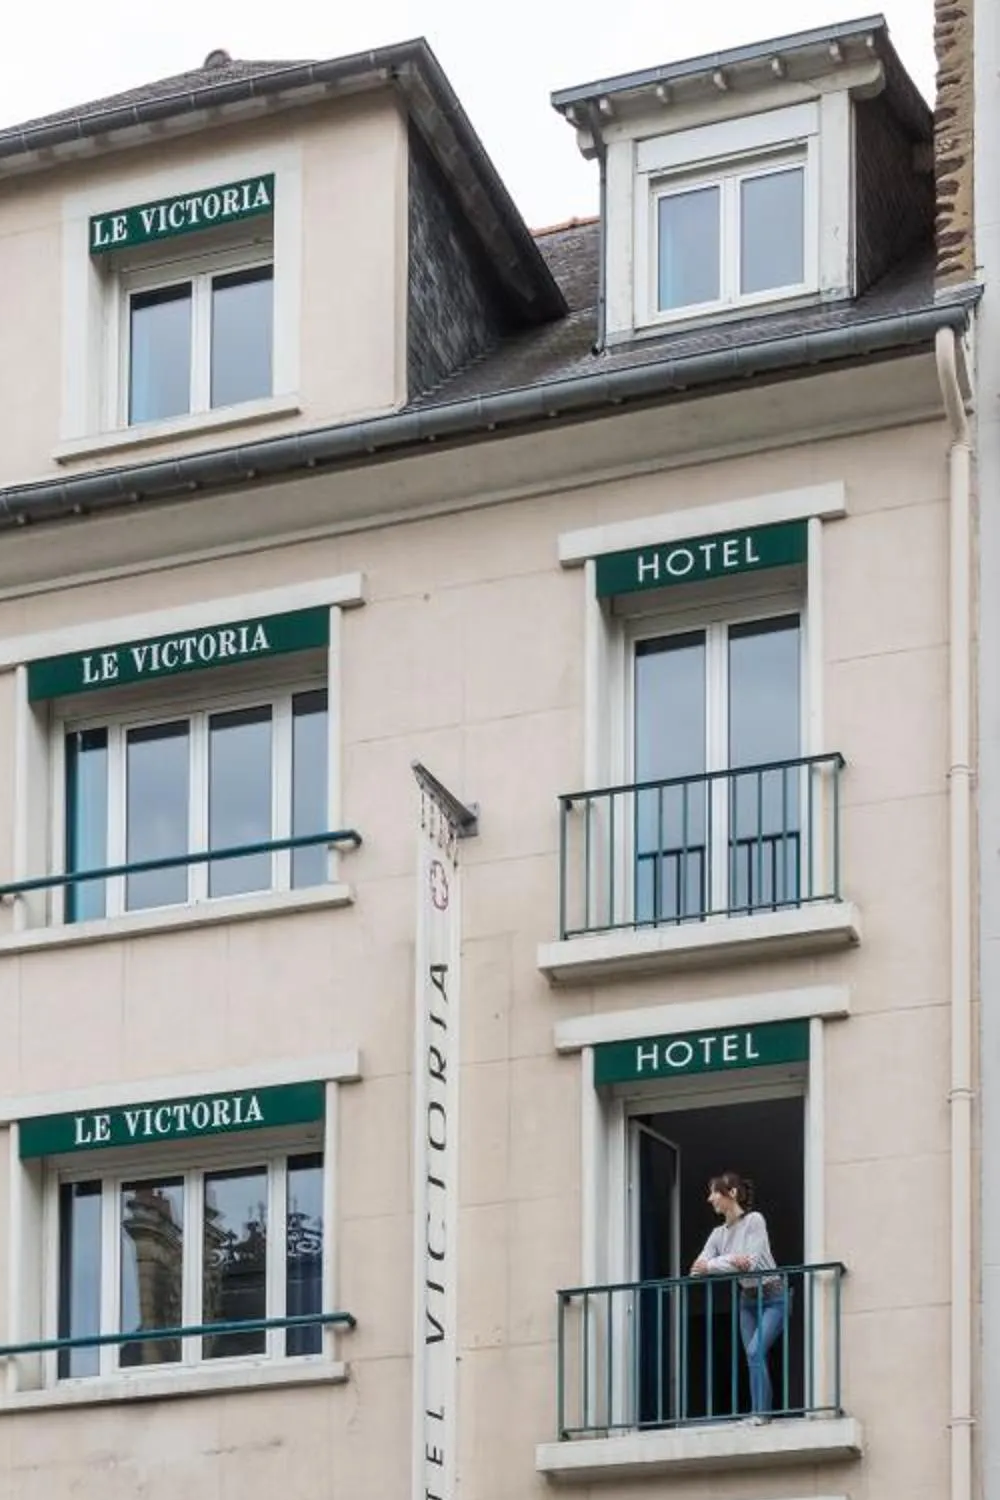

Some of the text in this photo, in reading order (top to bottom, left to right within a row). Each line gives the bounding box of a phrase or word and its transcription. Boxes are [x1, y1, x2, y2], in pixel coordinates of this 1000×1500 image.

[92, 180, 272, 248] LE VICTORIA
[637, 536, 761, 583] HOTEL
[82, 624, 270, 684] LE VICTORIA
[637, 1032, 760, 1071] HOTEL
[74, 1095, 265, 1145] LE VICTORIA
